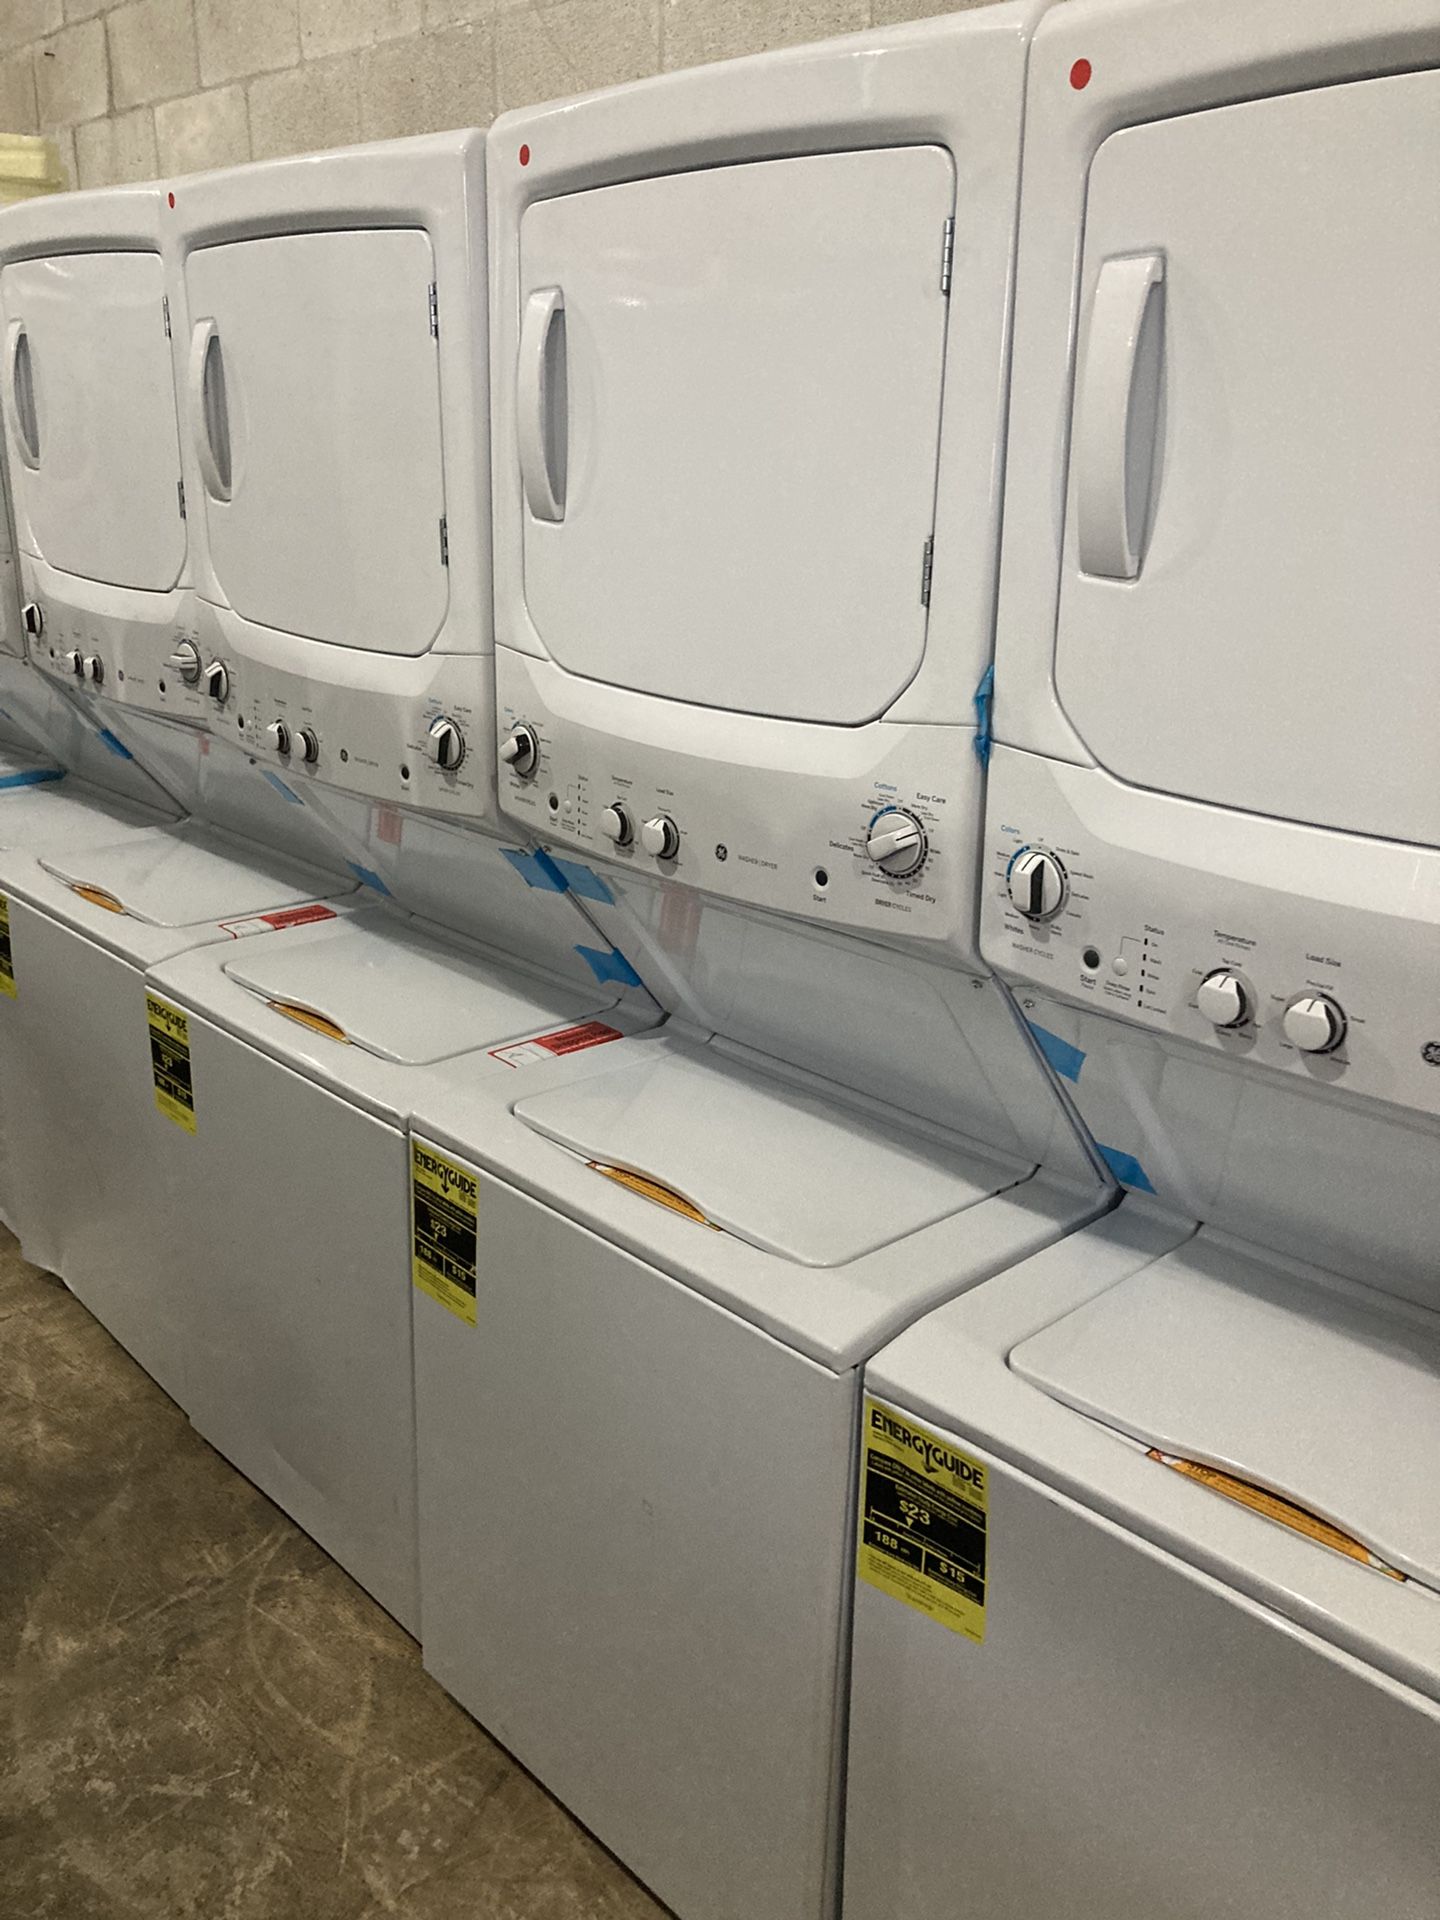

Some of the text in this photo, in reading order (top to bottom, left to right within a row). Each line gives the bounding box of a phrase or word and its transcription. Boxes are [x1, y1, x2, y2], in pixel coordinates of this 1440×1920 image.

[874, 781, 897, 792] Cottons
[916, 792, 947, 804] Easy Care
[829, 840, 854, 852] Delicates
[813, 894, 826, 903] Start
[906, 890, 936, 904] Timed Dry
[1144, 924, 1165, 935] Status
[1214, 929, 1256, 946] Temperature
[1306, 953, 1342, 967] Load Size
[1080, 974, 1096, 985] Start
[415, 1152, 477, 1199] ENERGYGUIDE
[871, 1408, 984, 1490] ENERGYGUIDE
[899, 1500, 931, 1526] $23
[874, 1531, 899, 1549] 188
[939, 1561, 966, 1584] $15
